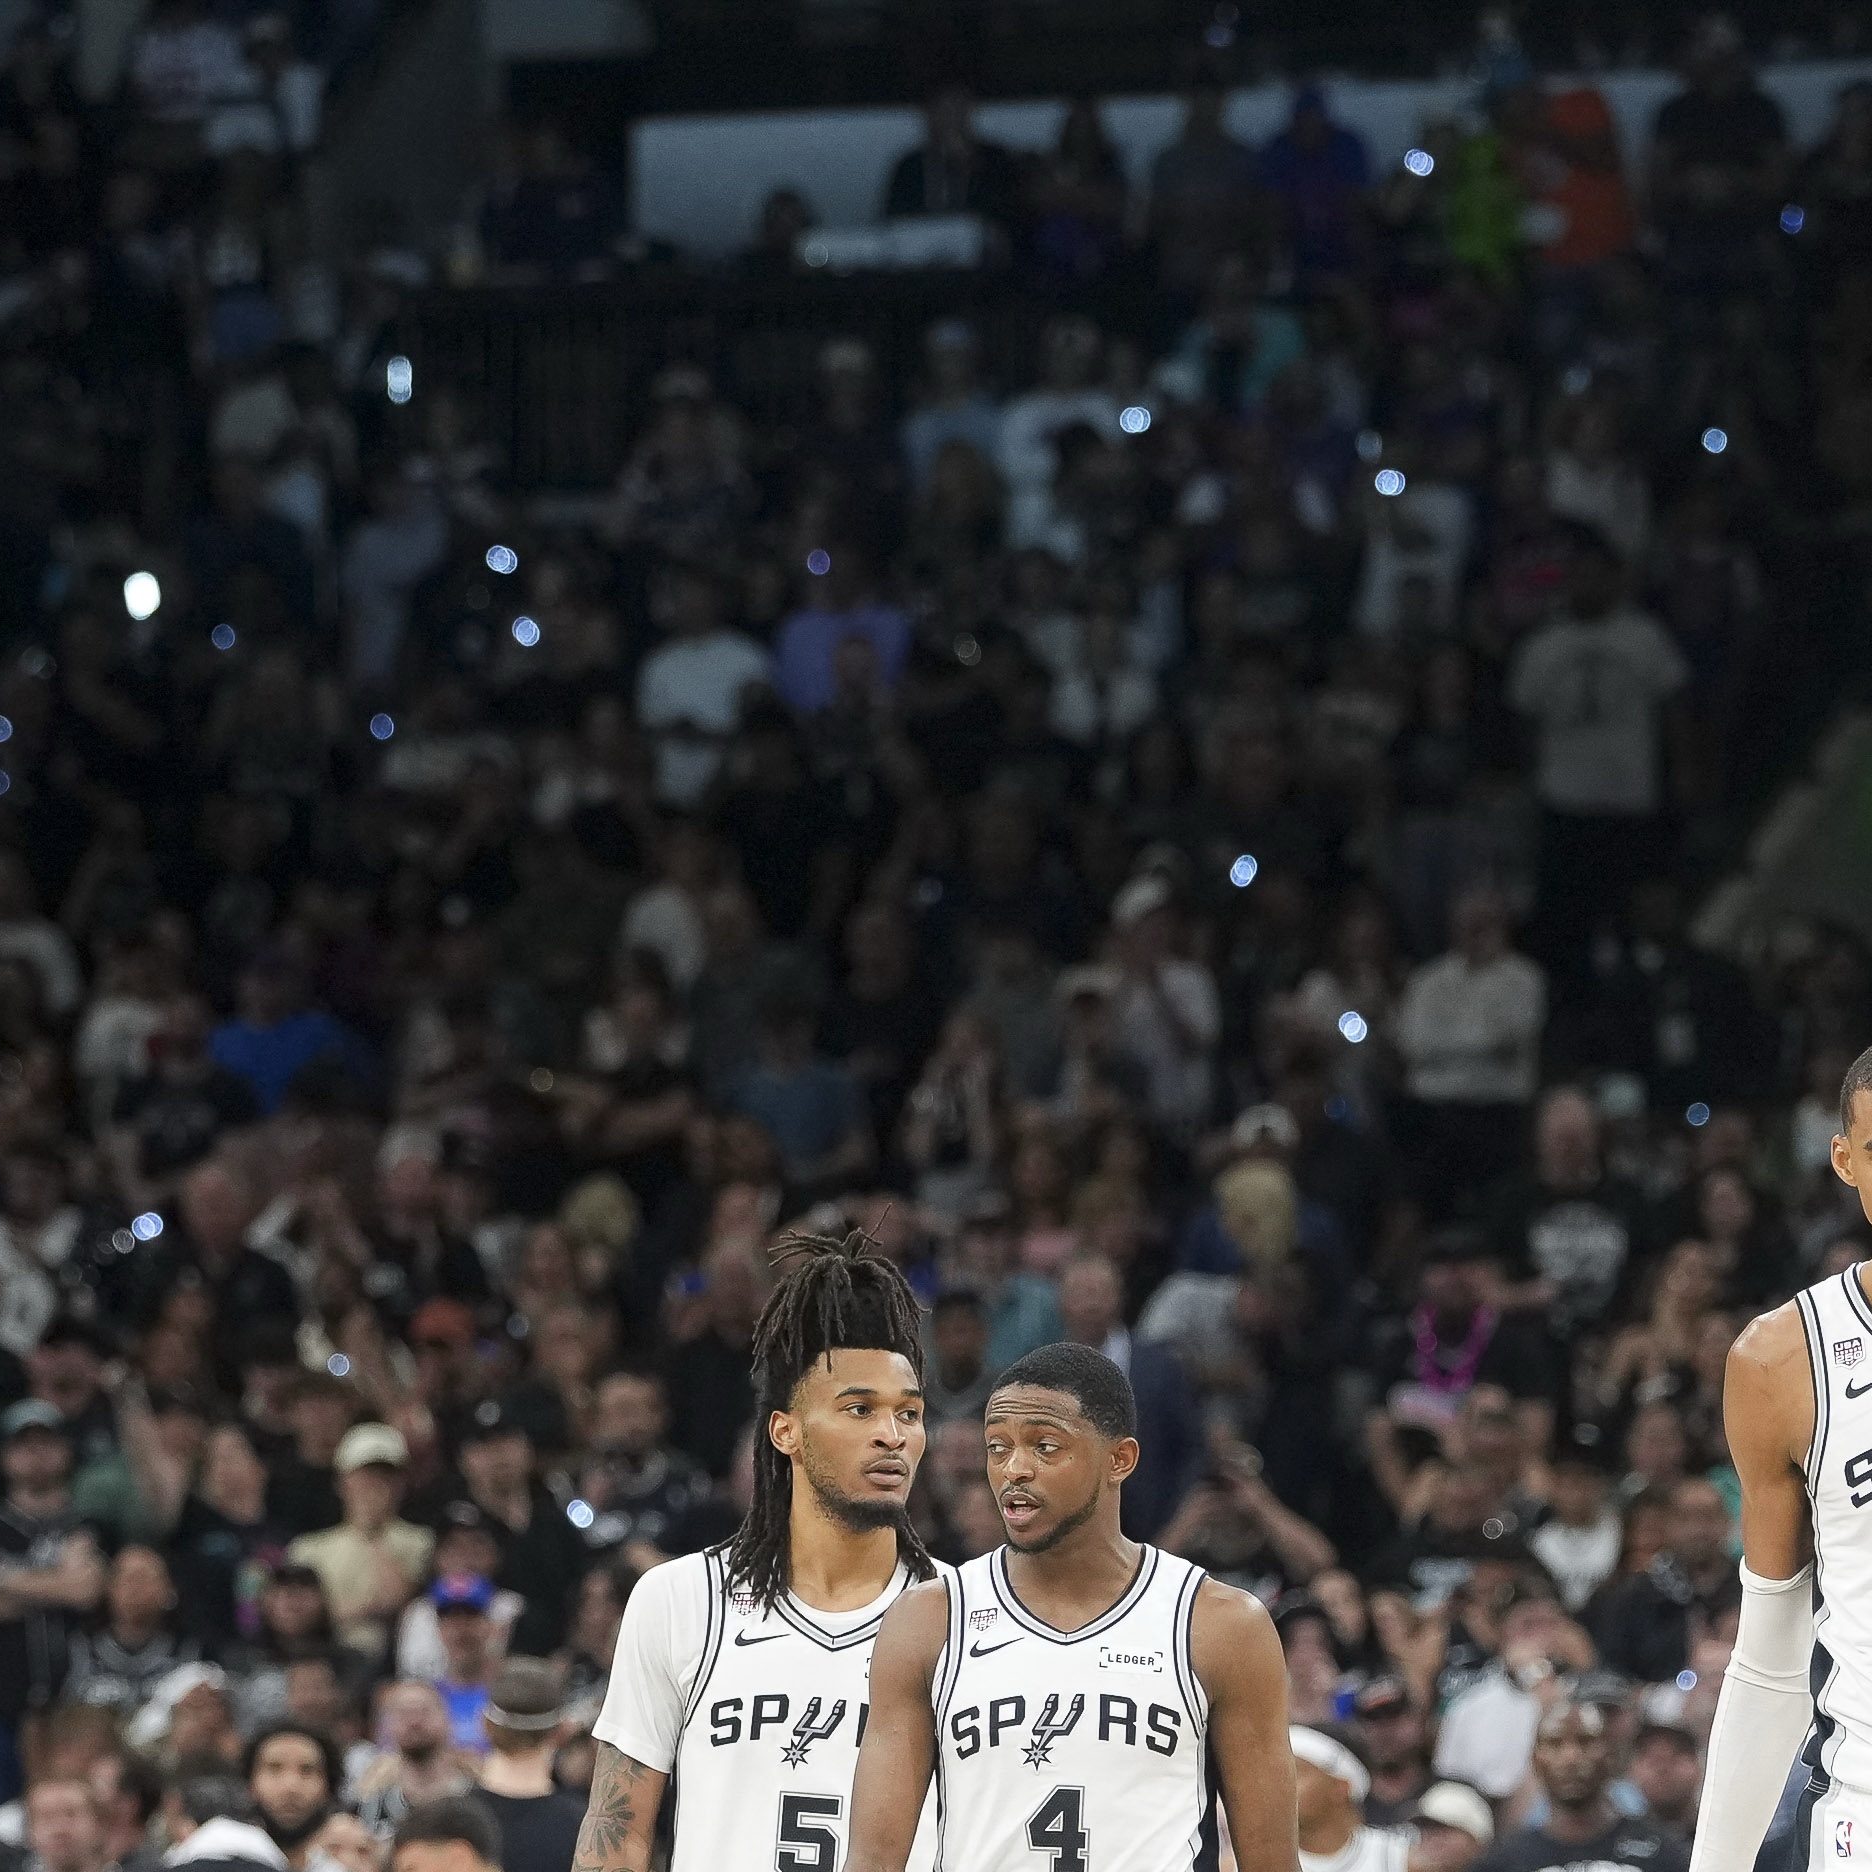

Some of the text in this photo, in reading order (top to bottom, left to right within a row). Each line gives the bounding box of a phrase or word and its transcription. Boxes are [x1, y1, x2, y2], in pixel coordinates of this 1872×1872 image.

[1107, 1652, 1156, 1668] LEDGER
[710, 1694, 870, 1769] SPU
[951, 1693, 1182, 1769] SPURS
